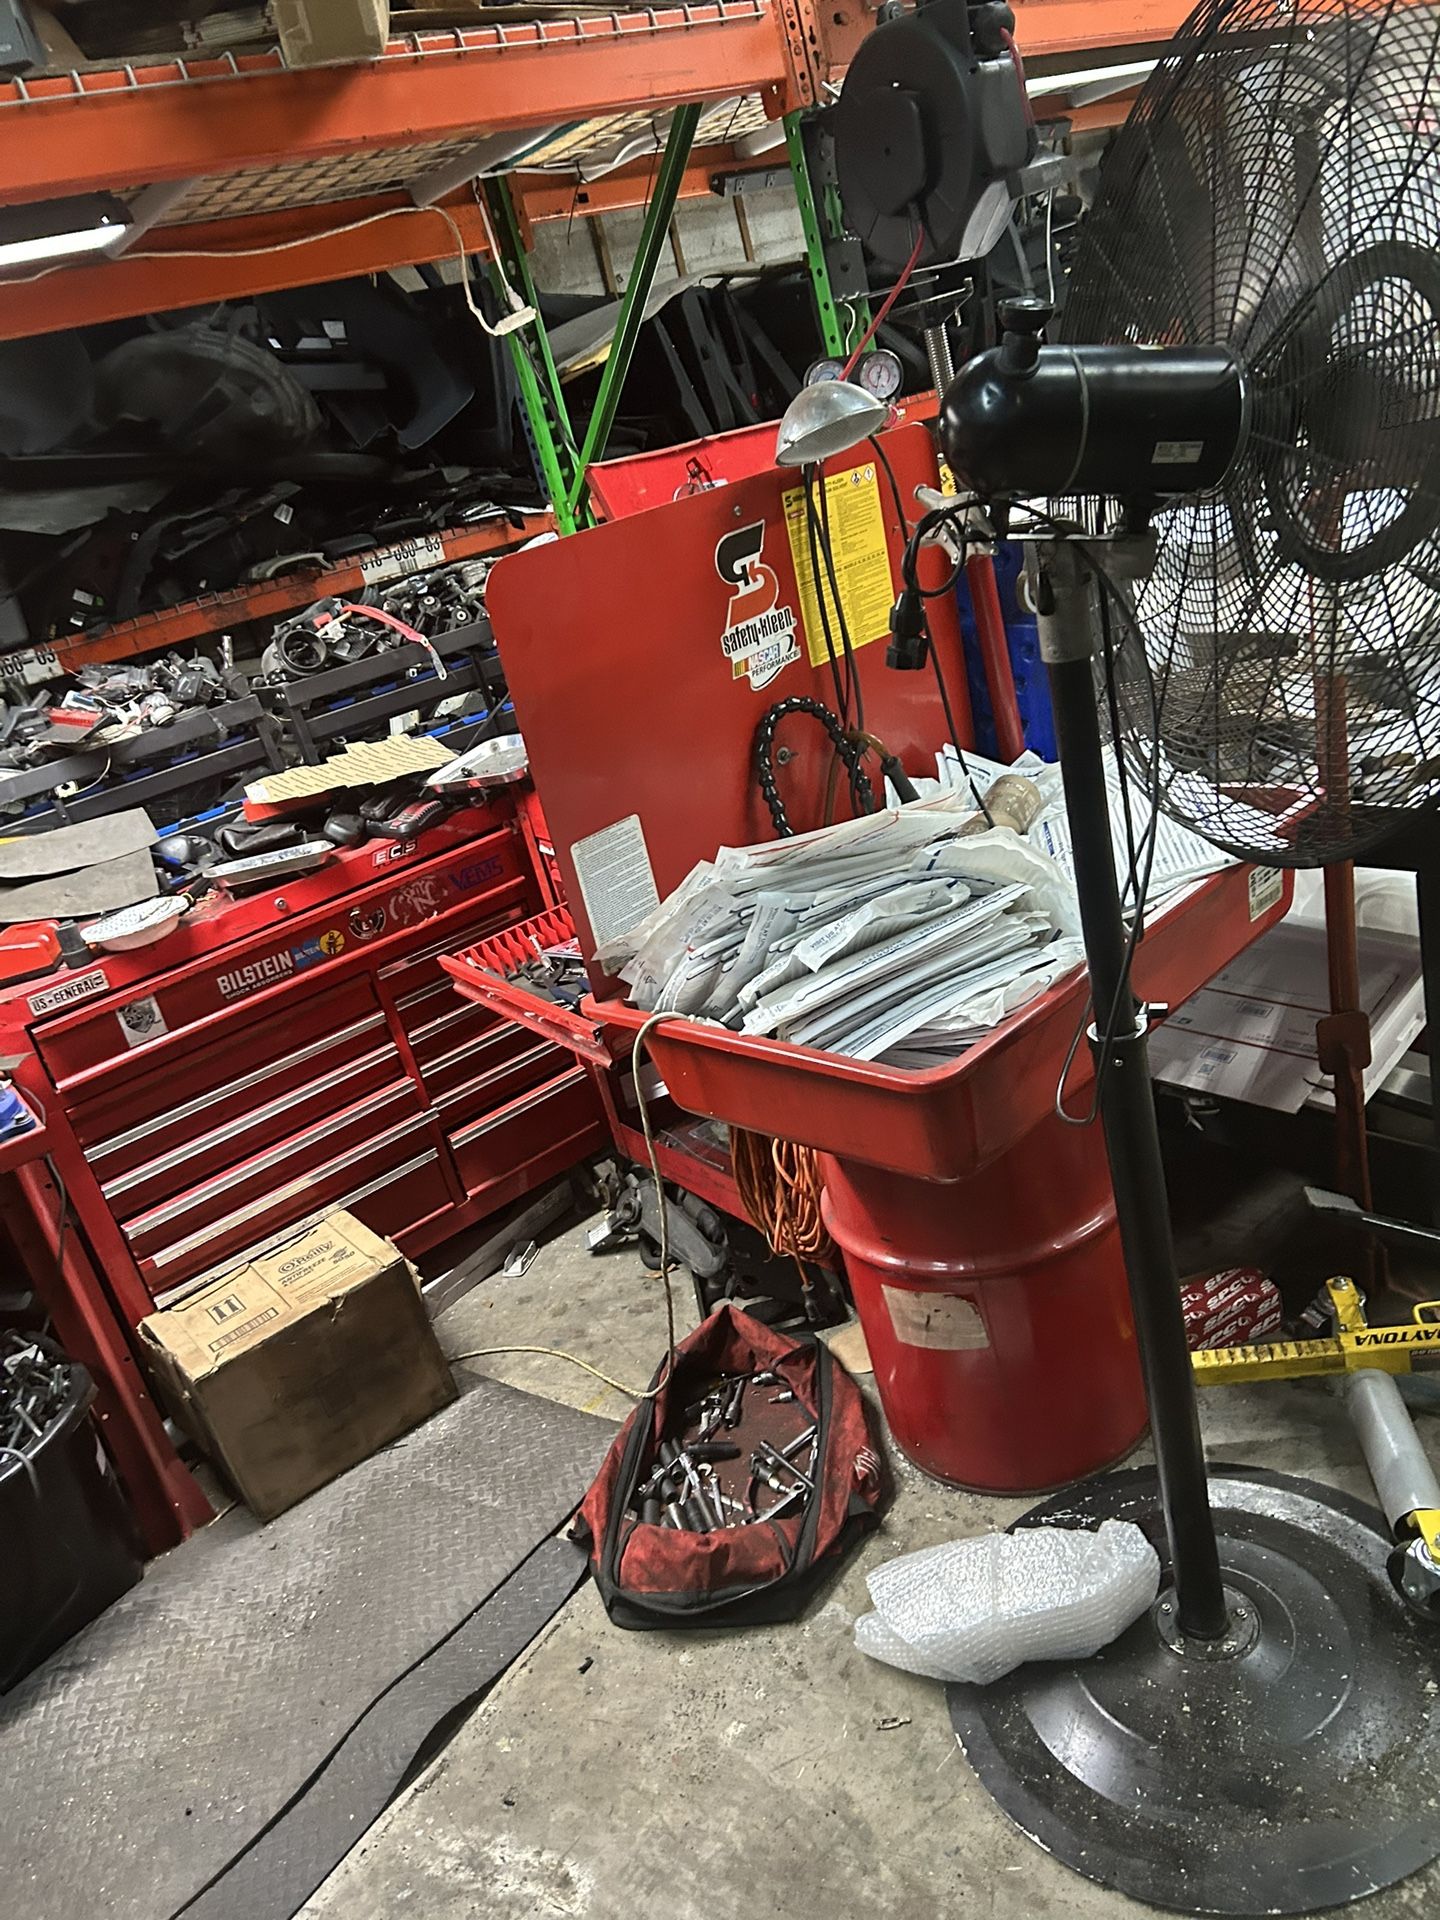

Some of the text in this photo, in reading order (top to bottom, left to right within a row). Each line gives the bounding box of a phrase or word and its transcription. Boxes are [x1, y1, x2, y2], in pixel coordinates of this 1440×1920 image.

[749, 643, 781, 666] NASCAR
[751, 649, 800, 677] PERFORMANCE
[375, 840, 416, 866] ECS
[216, 950, 294, 996] BILSTEIN
[226, 969, 294, 1000] SHOCK ABSORBERS
[278, 1240, 336, 1274] O'Reilly
[1206, 1279, 1243, 1309] SPC
[1203, 1297, 1247, 1332] SPC
